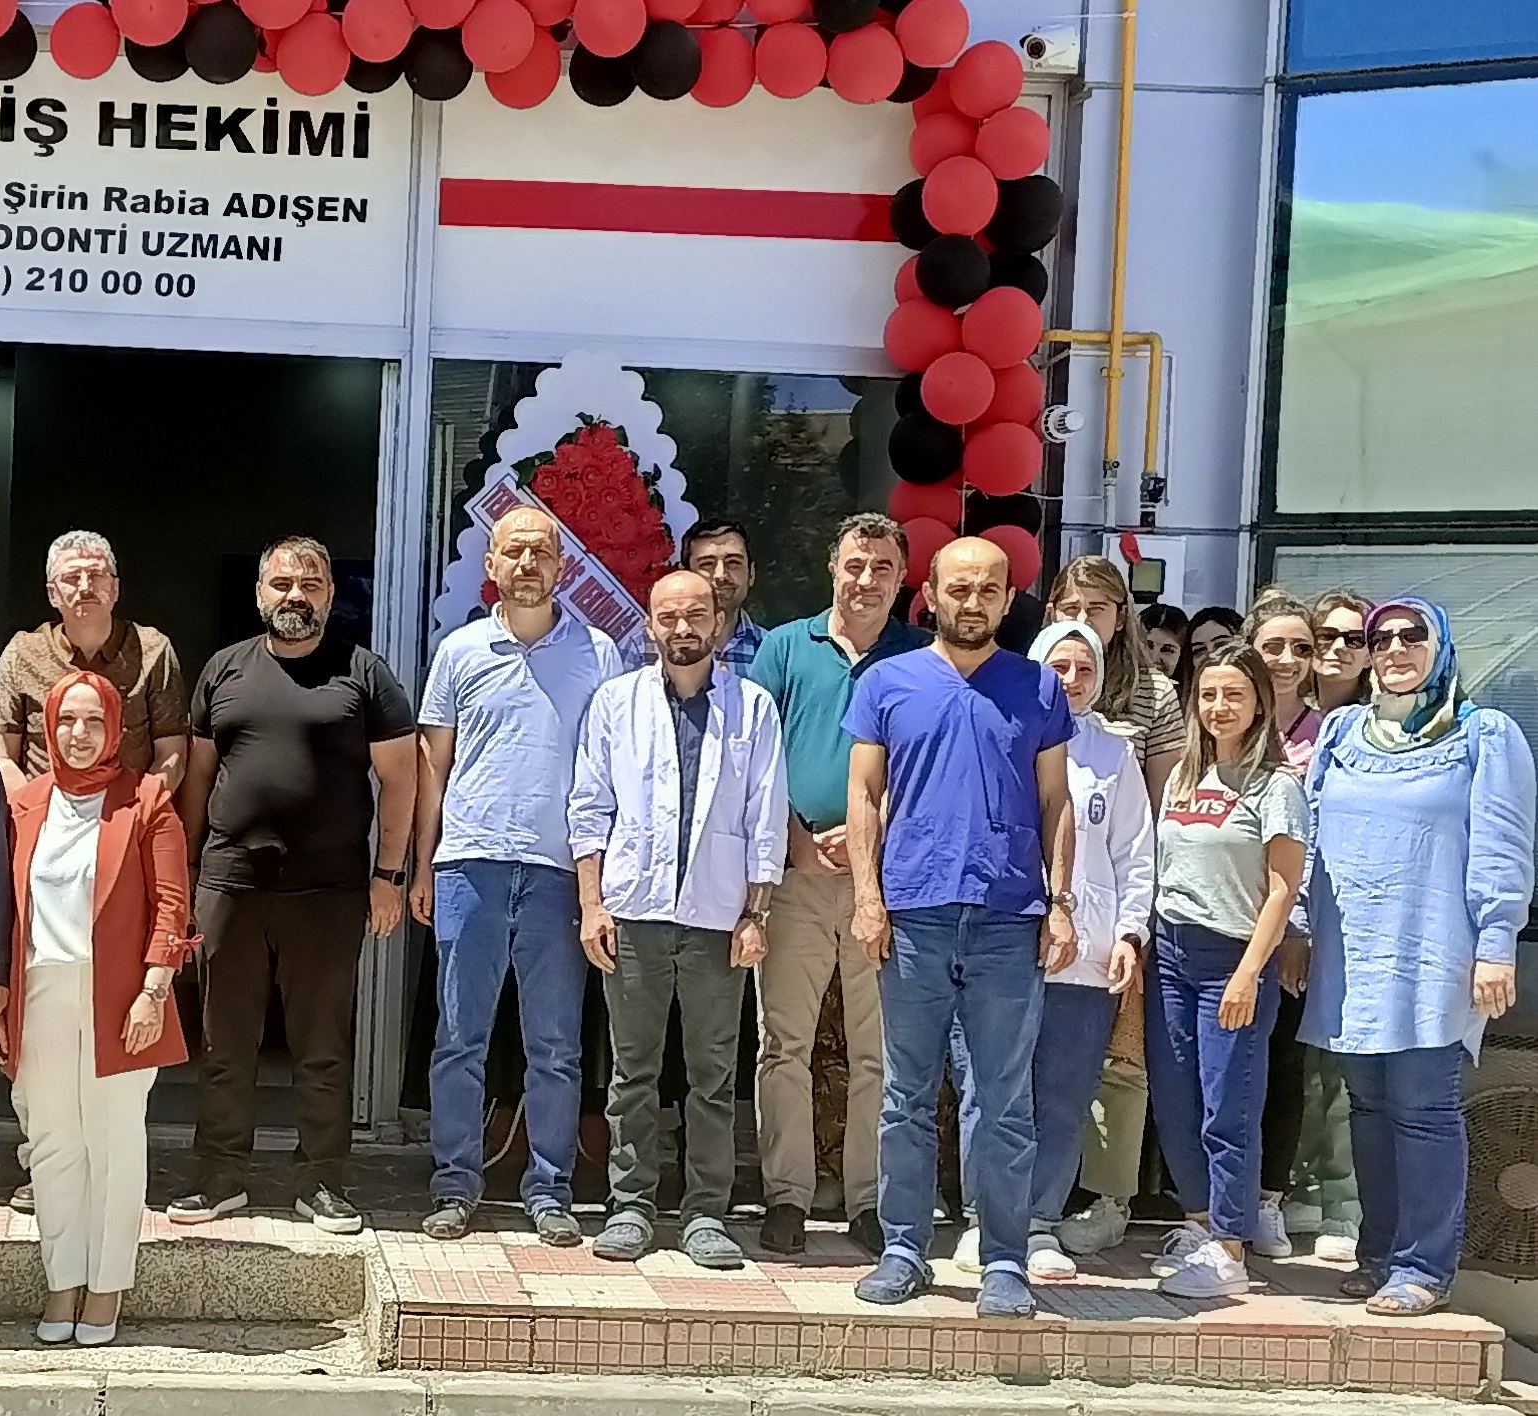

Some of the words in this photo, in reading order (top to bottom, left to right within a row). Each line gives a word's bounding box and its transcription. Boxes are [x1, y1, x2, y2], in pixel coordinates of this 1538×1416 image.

[98, 97, 370, 158] HEKİMİ
[3, 182, 89, 214] Şirin
[103, 187, 209, 216] Rabia
[223, 192, 368, 227] ADIŞEN
[142, 231, 282, 261] UZMANI
[25, 267, 89, 293] 210
[101, 270, 142, 295] 00
[155, 273, 195, 297] 00
